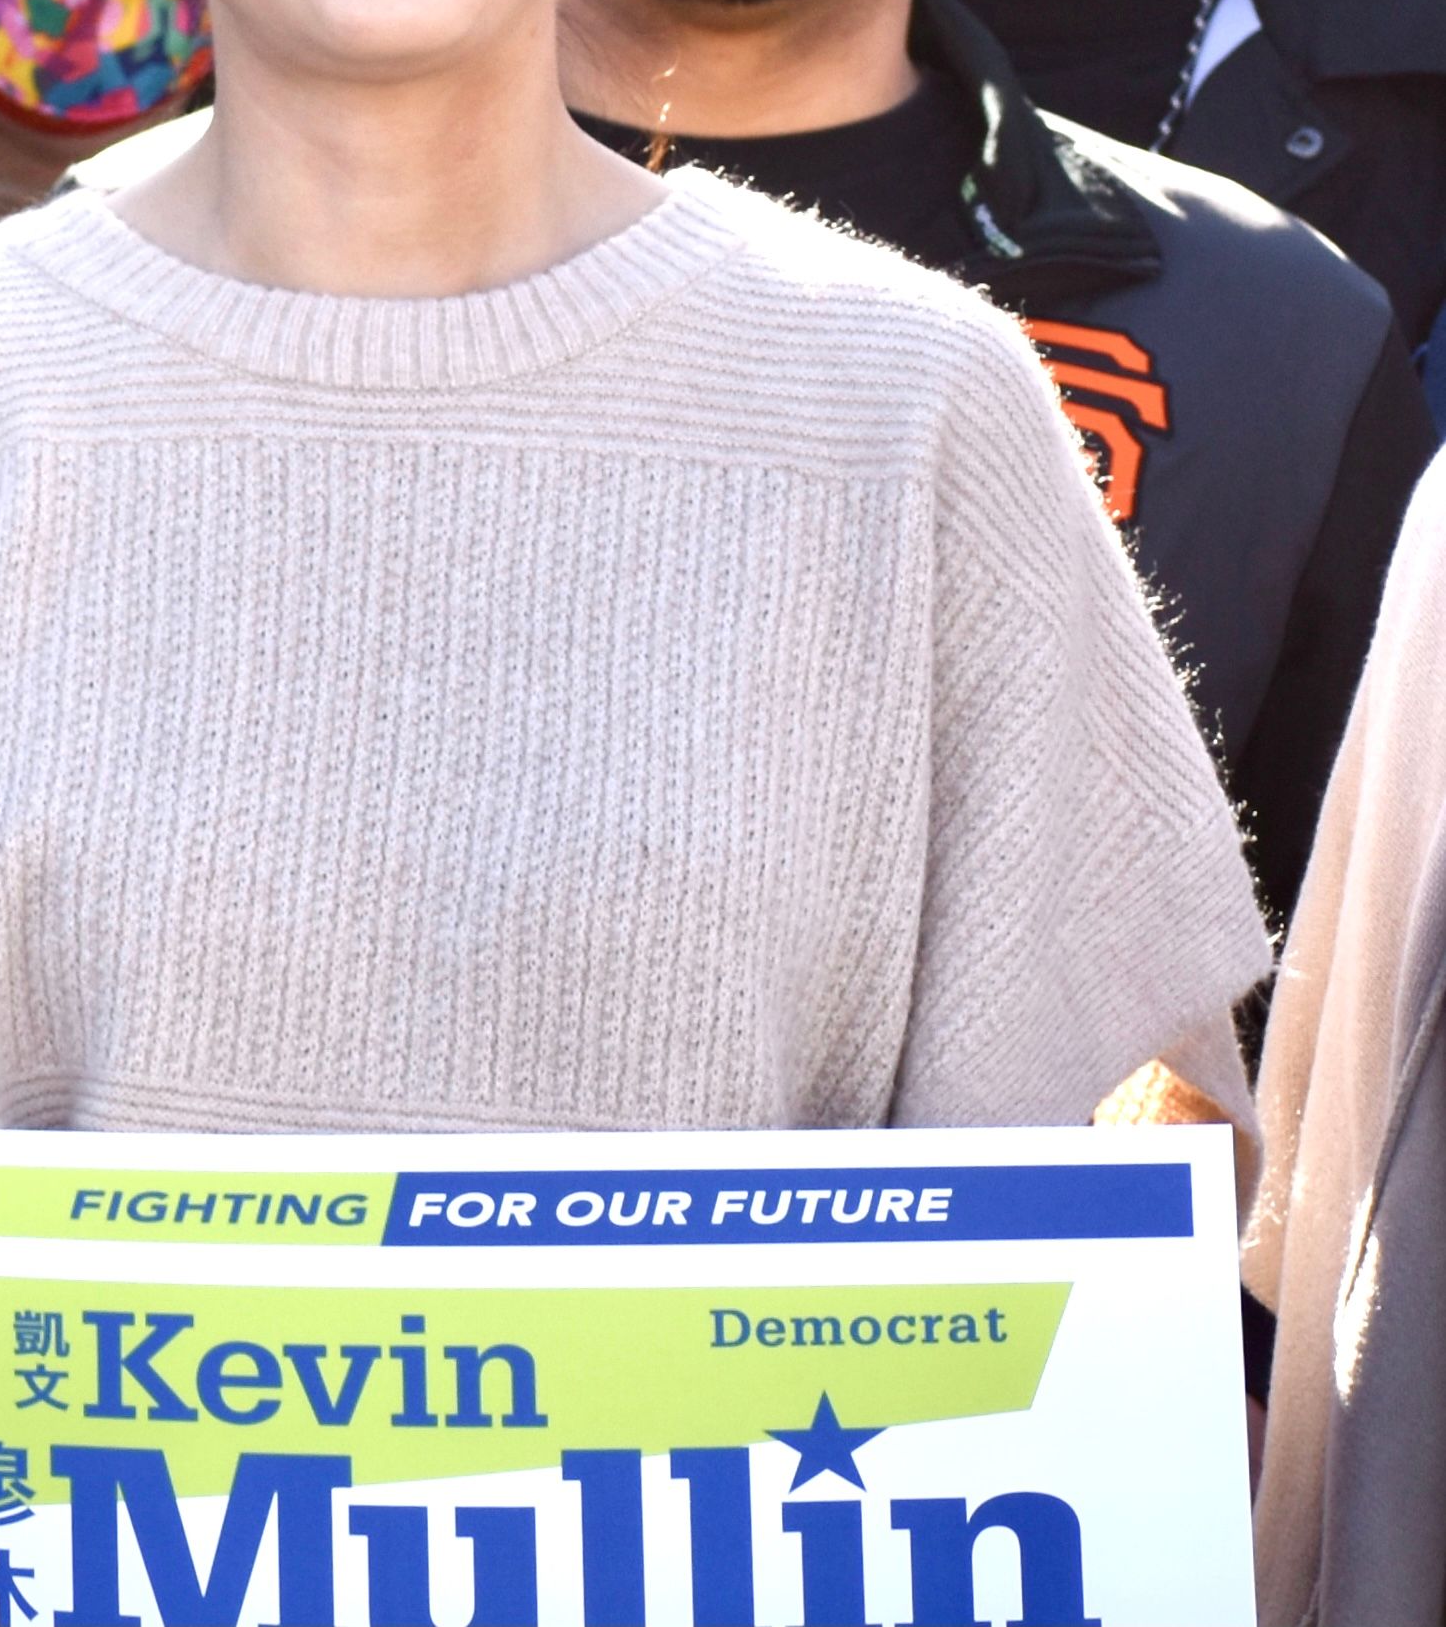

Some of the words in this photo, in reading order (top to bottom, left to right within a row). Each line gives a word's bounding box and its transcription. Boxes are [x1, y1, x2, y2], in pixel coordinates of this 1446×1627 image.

[69, 1188, 371, 1227] FIGHTING
[408, 1191, 536, 1229] FOR
[555, 1189, 695, 1228] OUR
[710, 1187, 954, 1226] FUTURE
[12, 1308, 71, 1413] 凱文
[81, 1309, 549, 1429] Kevin
[708, 1305, 1009, 1350] Democrat
[48, 1387, 1104, 1627] Mullin
